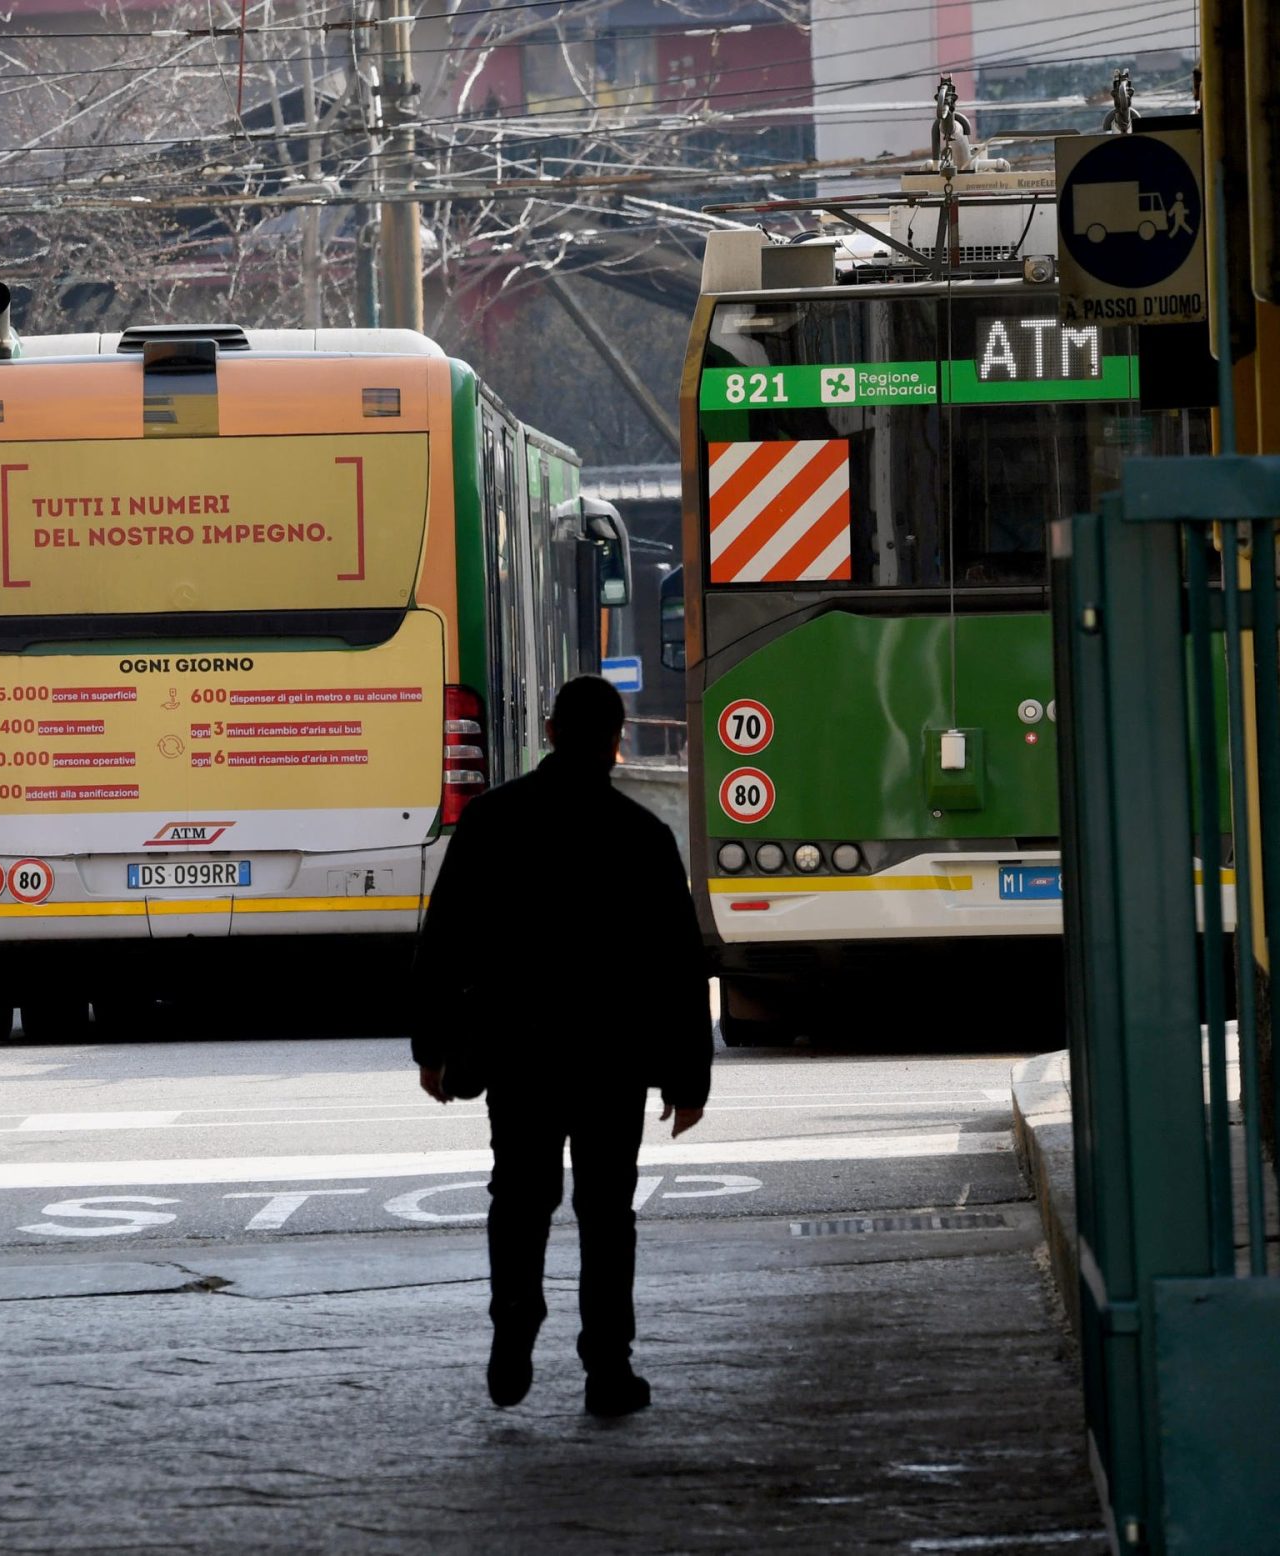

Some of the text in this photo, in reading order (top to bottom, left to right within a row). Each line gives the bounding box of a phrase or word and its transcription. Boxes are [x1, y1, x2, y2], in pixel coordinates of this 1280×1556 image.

[1065, 293, 1201, 320] A PASSO D'UOMO
[980, 318, 1098, 379] ATM
[859, 372, 920, 385] Regione
[726, 372, 789, 404] 821
[859, 384, 937, 397] Lombardia
[32, 494, 230, 518] TUTTI I NUMERI
[34, 522, 333, 548] DEL NOSTRO IMPEGNO.
[119, 658, 254, 673] OGNI GIORNO
[52, 692, 79, 701] corse
[80, 692, 89, 700] in
[91, 690, 137, 702] superficie
[191, 688, 227, 703] 600
[230, 694, 276, 704] dispenser
[277, 693, 286, 702] di
[288, 693, 303, 704] gel
[304, 693, 313, 702] in
[316, 693, 343, 702] metro
[367, 692, 397, 701] alcune
[400, 691, 422, 700] linee
[38, 726, 64, 734] corse
[66, 725, 76, 733] in
[77, 724, 104, 733] metro
[191, 721, 362, 738] ogni 3 minuti ricambio d'aria sui bus
[732, 714, 761, 740] 70
[53, 758, 90, 768] persone
[93, 756, 136, 766] operative
[191, 750, 368, 767] ogni 6 minuti ricambio d'aria in metro
[25, 790, 58, 800] addetti
[60, 789, 77, 799] alla
[79, 788, 139, 799] sanificazione
[734, 784, 761, 806] 80
[170, 827, 207, 840] ATM
[19, 871, 42, 890] 80
[141, 865, 166, 885] DS
[174, 863, 237, 885] 099RR
[1003, 873, 1023, 893] MI
